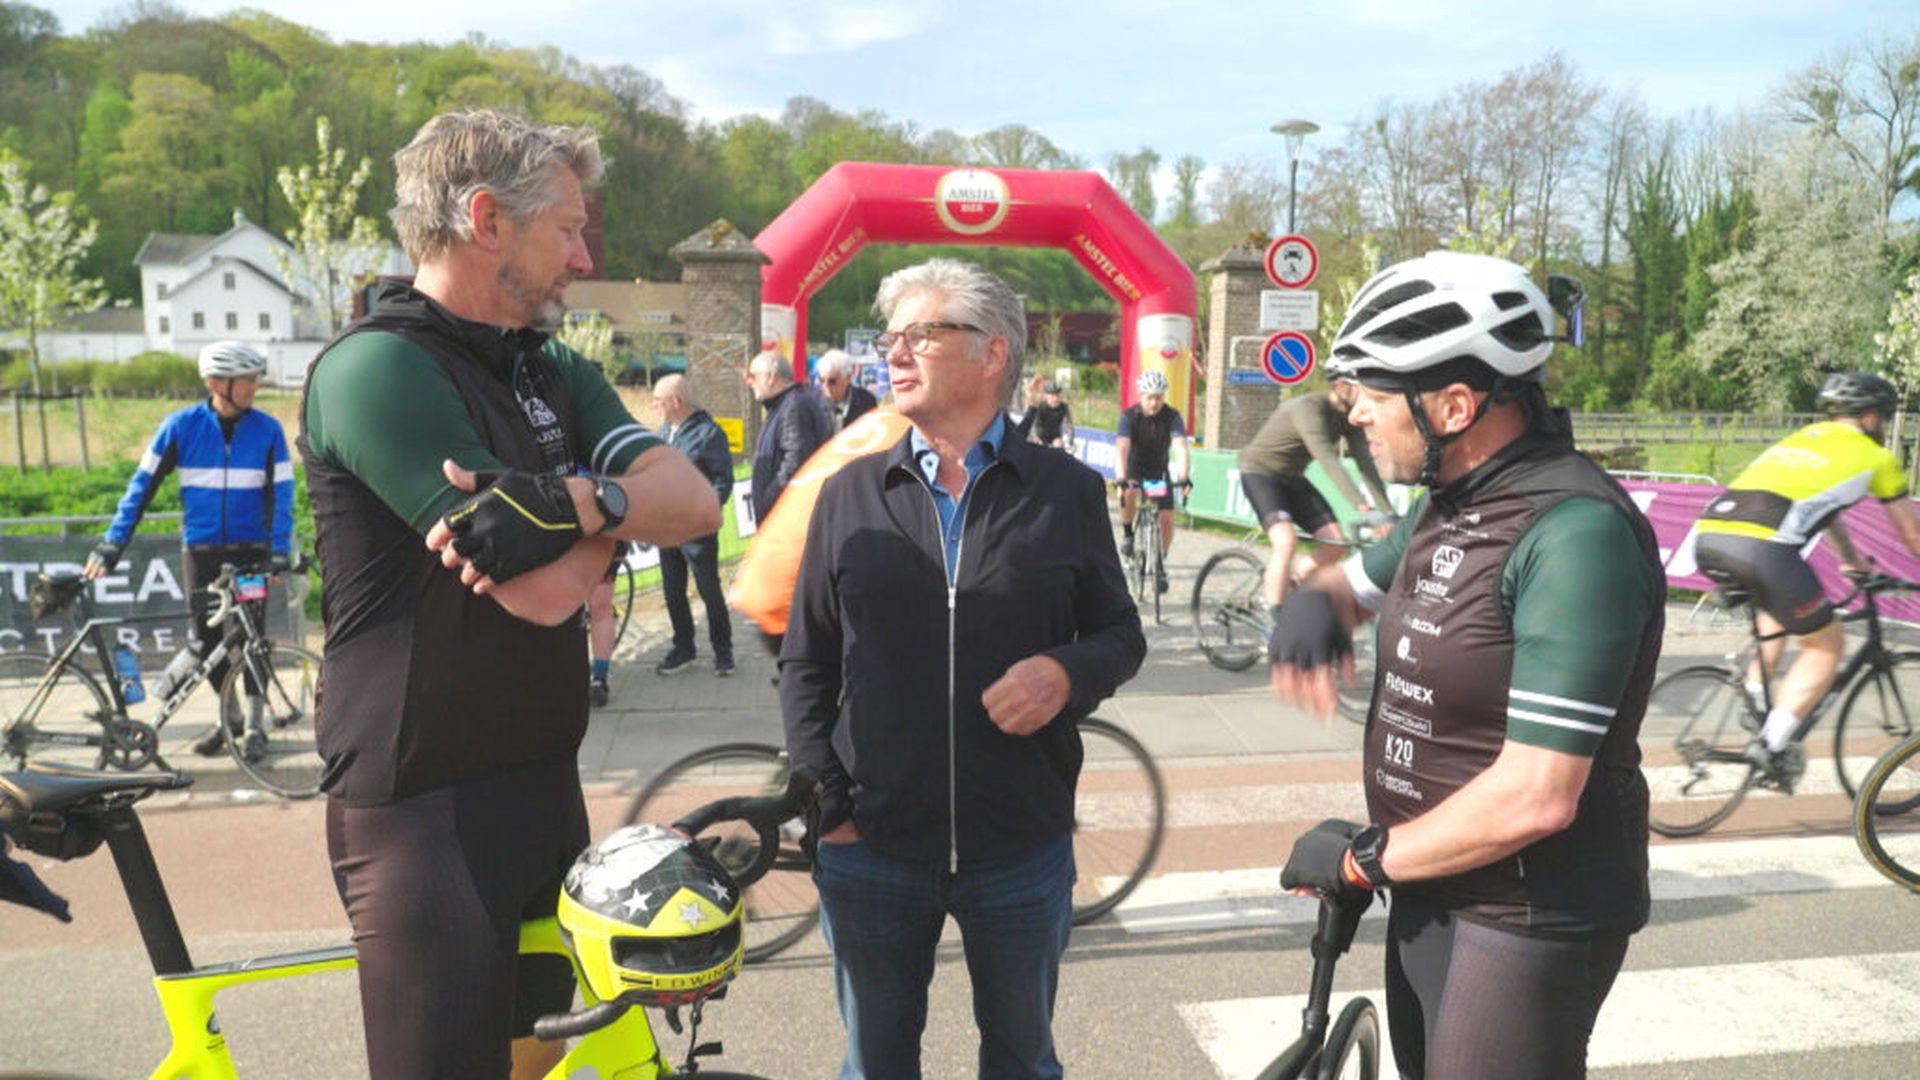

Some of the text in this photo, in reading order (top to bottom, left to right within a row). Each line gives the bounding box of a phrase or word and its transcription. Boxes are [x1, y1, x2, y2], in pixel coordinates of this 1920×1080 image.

[948, 187, 995, 200] AMSTEL
[961, 203, 984, 213] BIER
[1074, 233, 1117, 279] AMSTEL
[1384, 732, 1414, 768] K20
